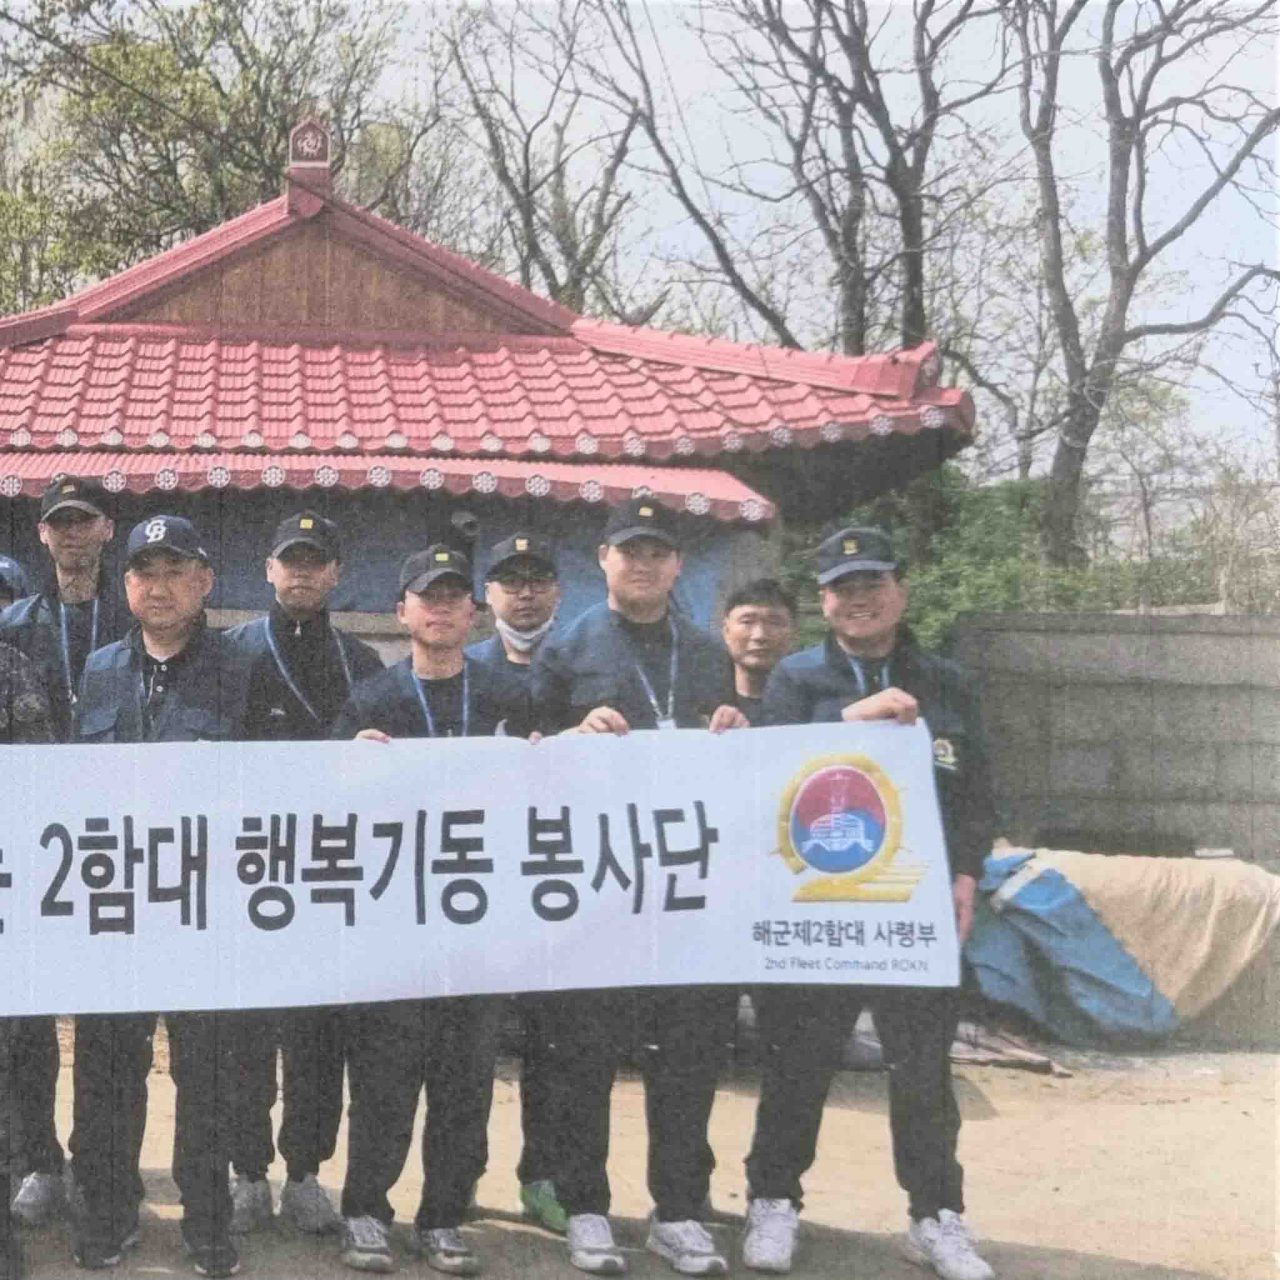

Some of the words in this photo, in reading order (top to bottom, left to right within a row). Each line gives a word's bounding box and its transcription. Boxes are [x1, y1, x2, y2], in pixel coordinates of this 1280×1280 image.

[39, 814, 208, 936] 2함대
[235, 809, 494, 932] 행복기동
[520, 800, 719, 922] 봉사단
[752, 919, 865, 948] 해군제2함대
[873, 921, 938, 948] 사령부
[790, 958, 820, 970] Fleet
[824, 958, 888, 971] Command
